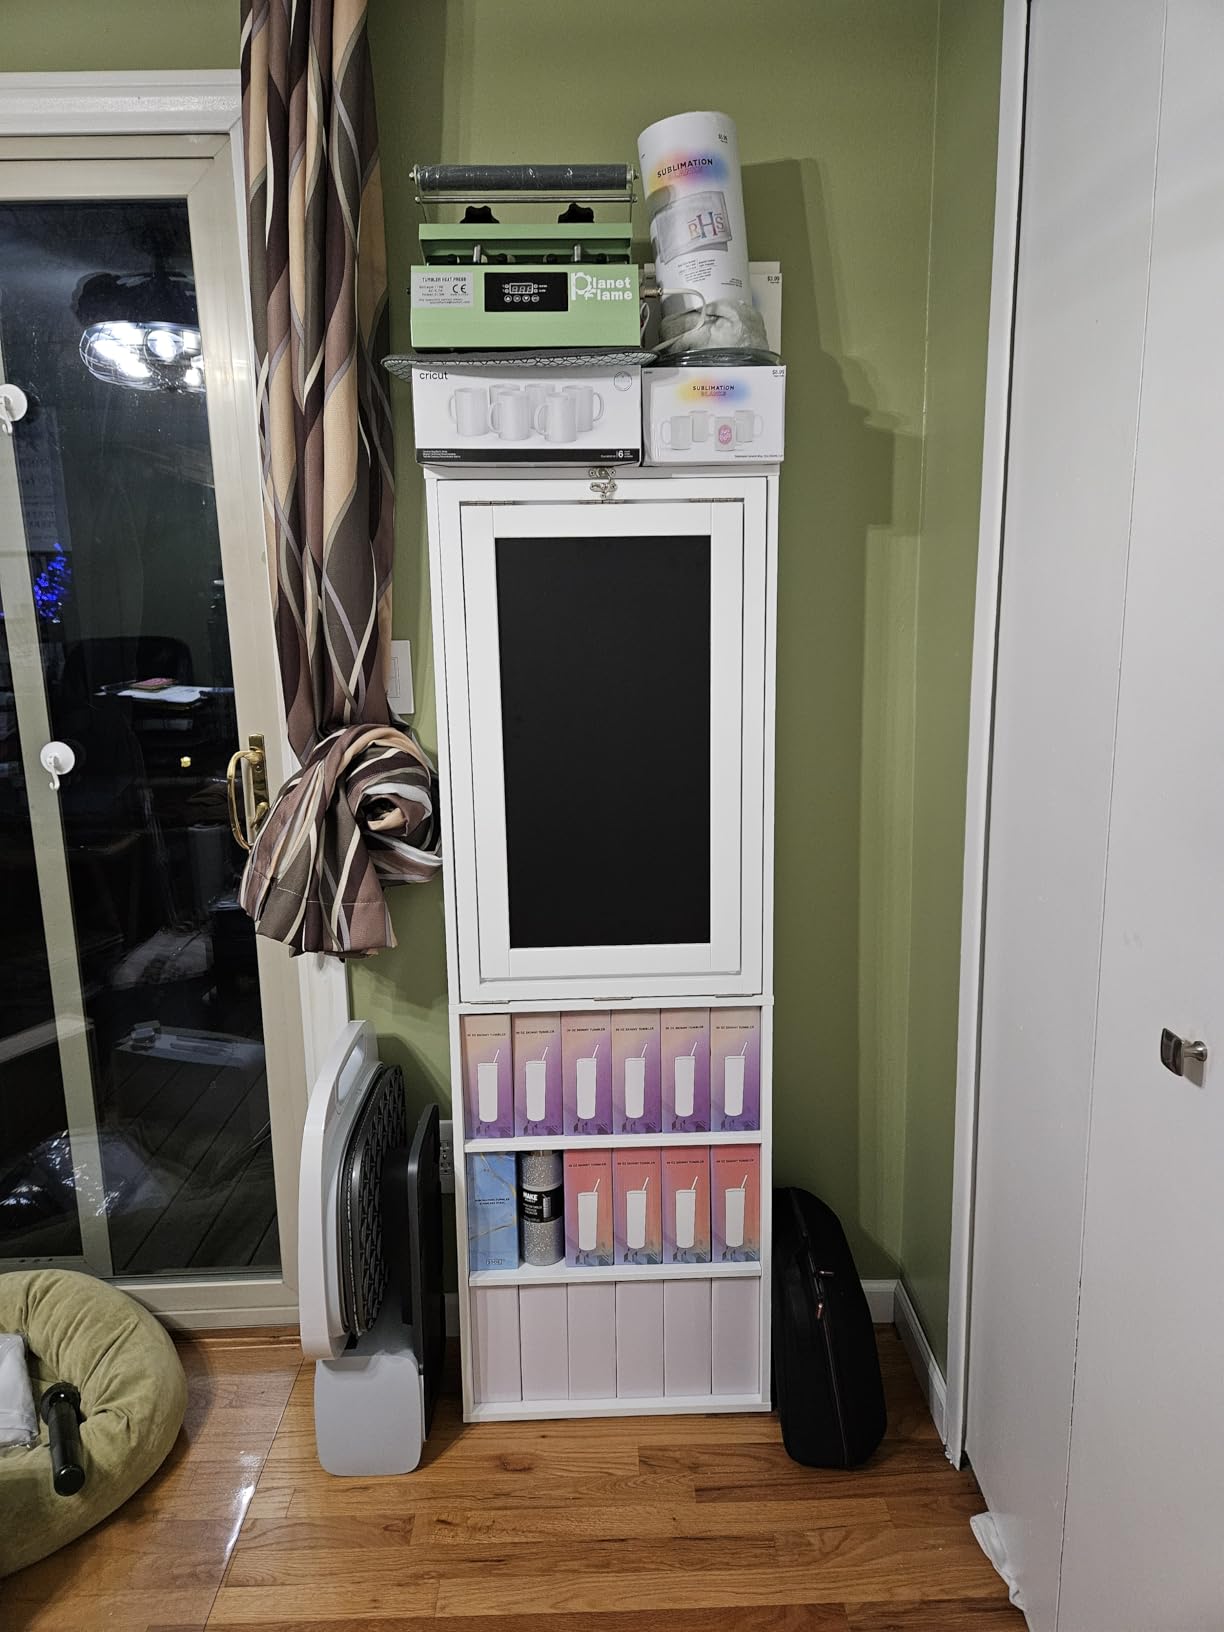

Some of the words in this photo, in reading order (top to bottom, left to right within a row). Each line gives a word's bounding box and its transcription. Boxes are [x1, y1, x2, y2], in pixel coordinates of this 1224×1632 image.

[657, 158, 713, 178] SUBLIMATION
[571, 272, 631, 300] Planet
[419, 371, 448, 380] cricut
[618, 450, 624, 458] 6
